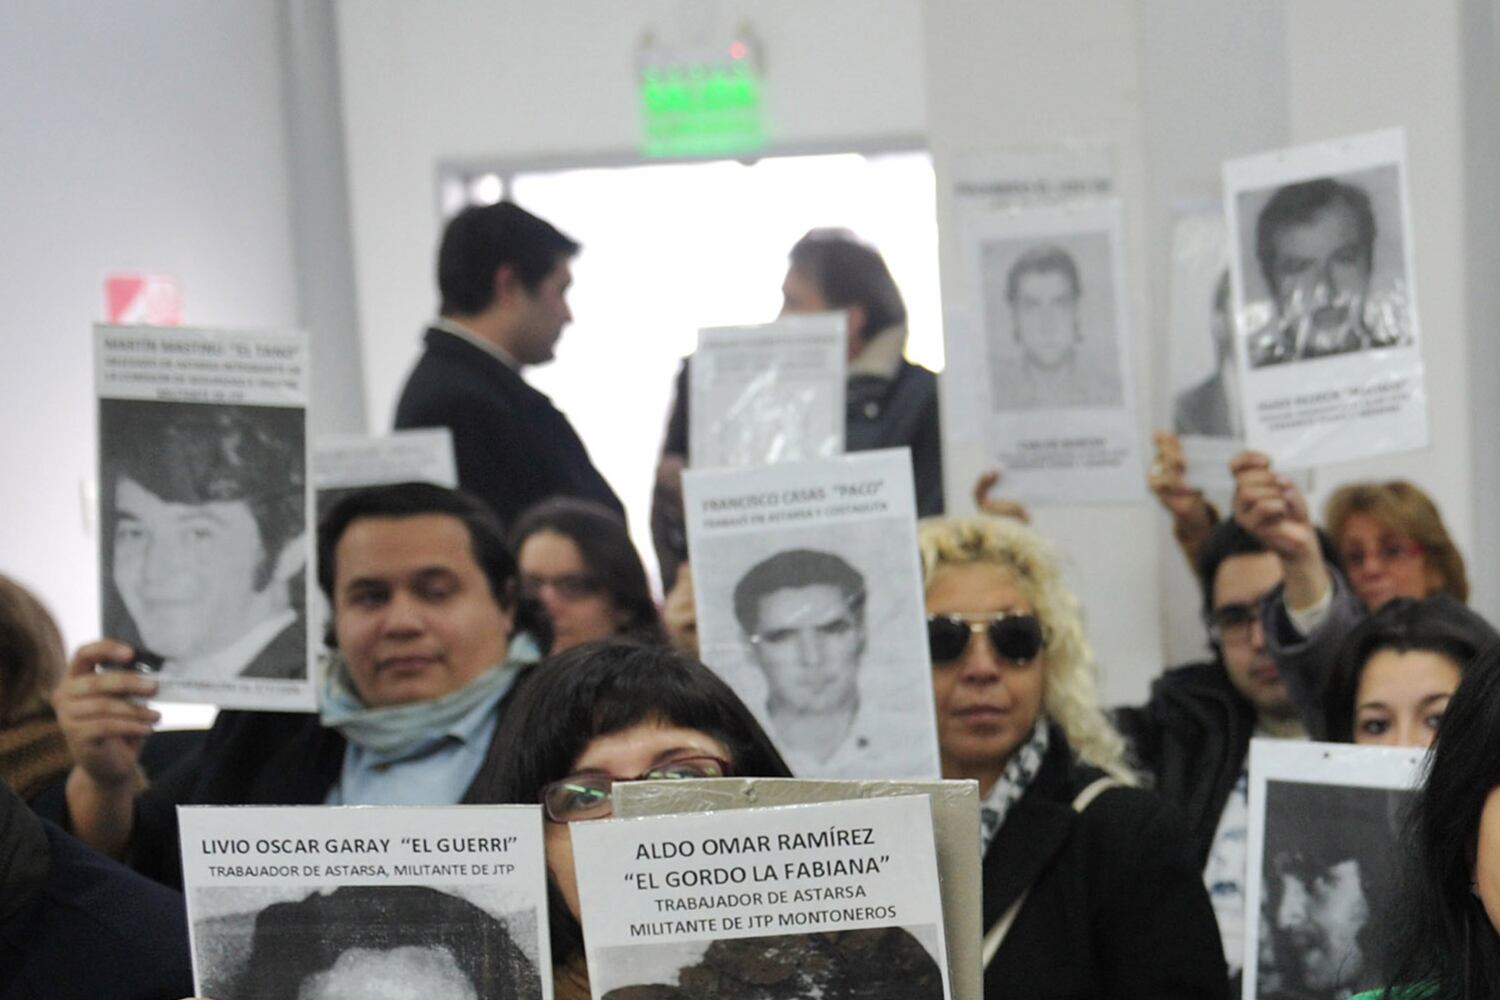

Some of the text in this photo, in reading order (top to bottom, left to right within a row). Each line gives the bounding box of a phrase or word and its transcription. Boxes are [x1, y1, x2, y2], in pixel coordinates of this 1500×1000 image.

[702, 491, 779, 512] FRANCISCO
[782, 488, 826, 507] CASAS
[202, 836, 517, 854] LIVIO OSCAR GARAY “EL GUERRI”
[635, 826, 875, 860] ALDO OMAR RAMÍREZ
[208, 863, 515, 878] TRABAJADOR DE ASTARSA, MILITANTE DE JTP
[624, 855, 890, 891] “EL GORDO LA FABIANA”
[654, 885, 867, 912] TRABAJADOR DE ASTARSA
[630, 905, 897, 936] MILITANTE DE JTP MONTONEROS
